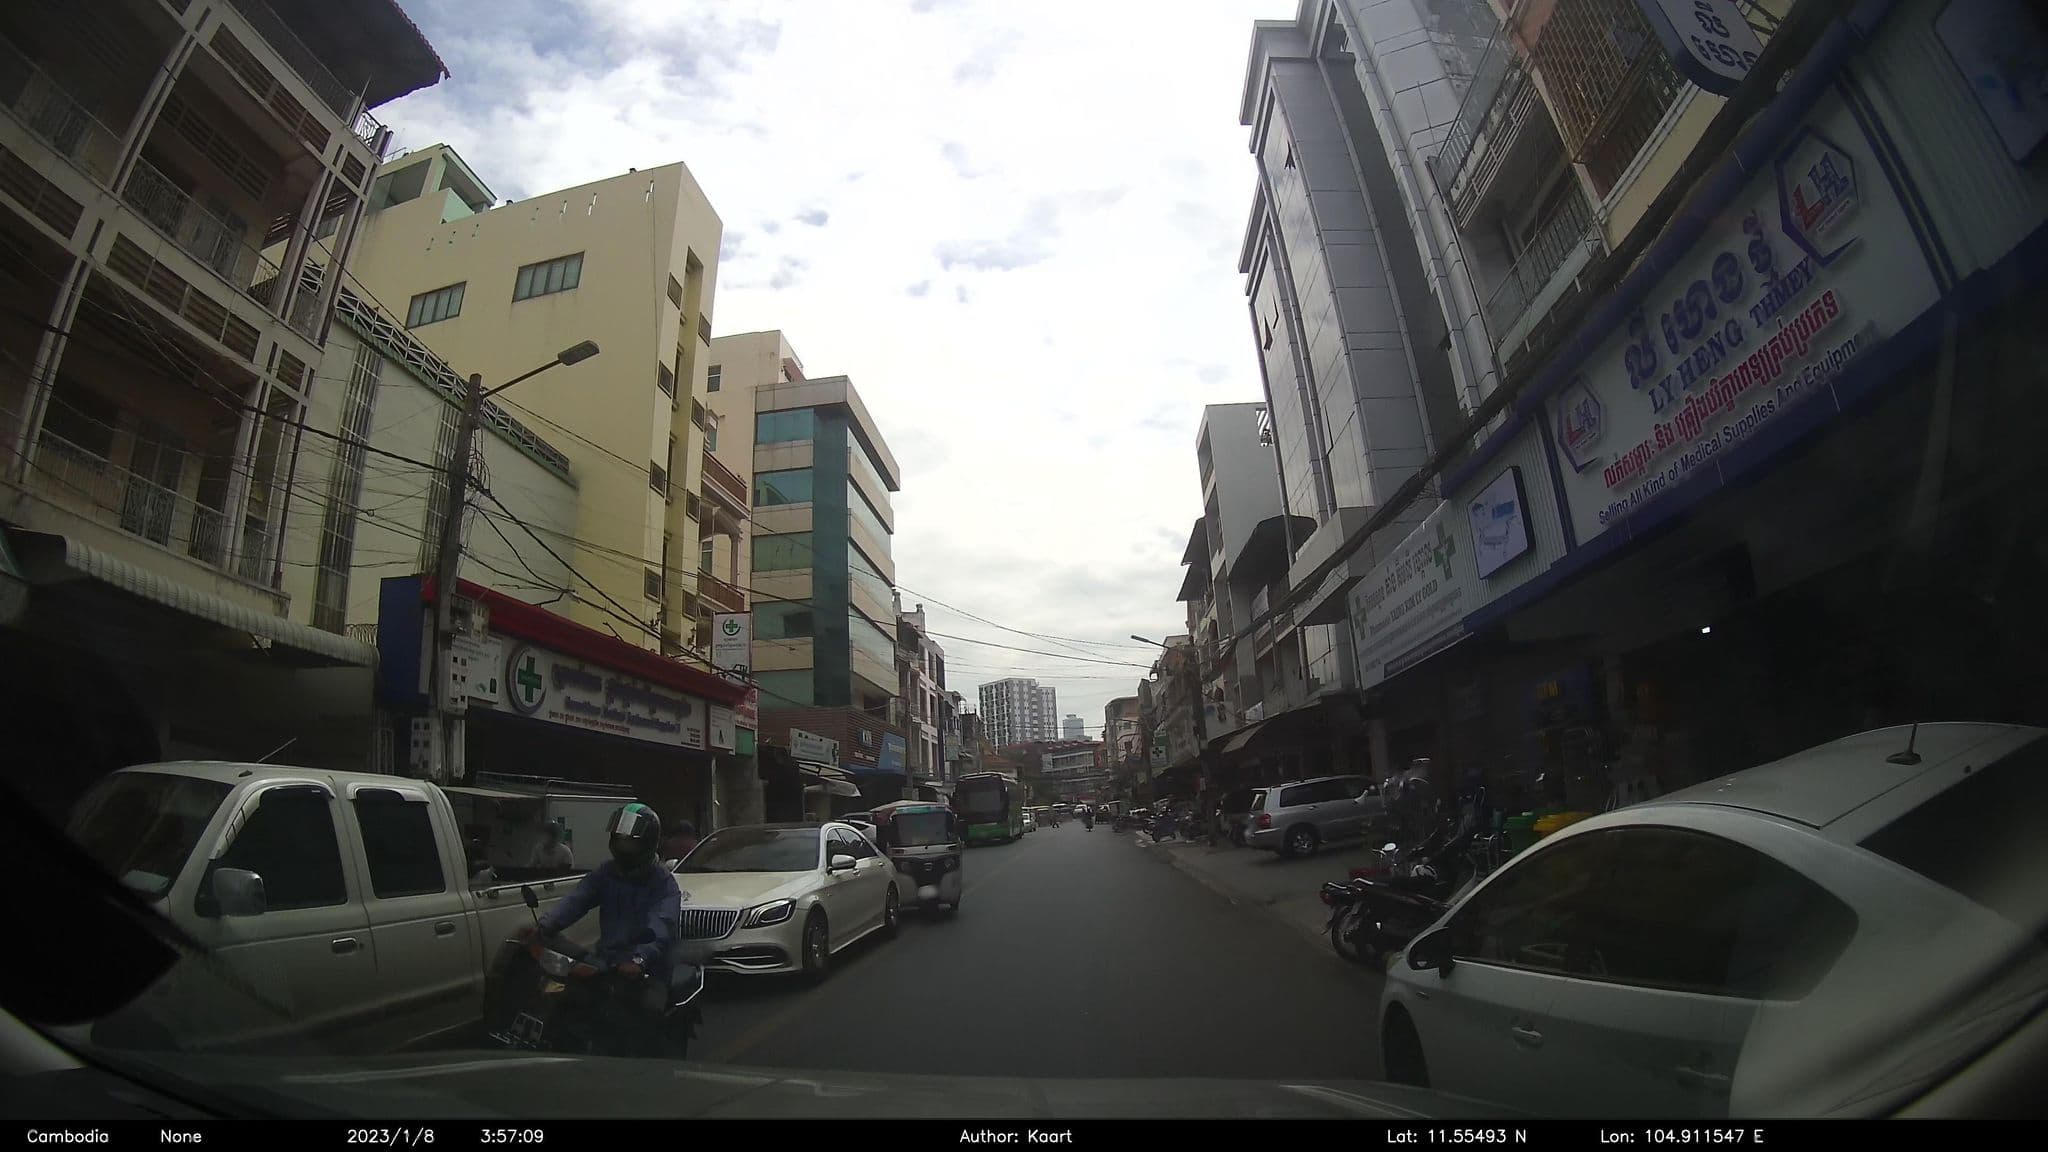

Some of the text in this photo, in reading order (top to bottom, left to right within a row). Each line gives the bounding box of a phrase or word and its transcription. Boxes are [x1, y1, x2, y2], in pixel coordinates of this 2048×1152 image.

[1648, 256, 1815, 415] LY HENG THMEY
[1629, 488, 1643, 507] All
[1642, 471, 1666, 497] Kind
[1668, 461, 1679, 482] of
[1680, 432, 1722, 474] Medical
[1723, 399, 1776, 443] Supplies
